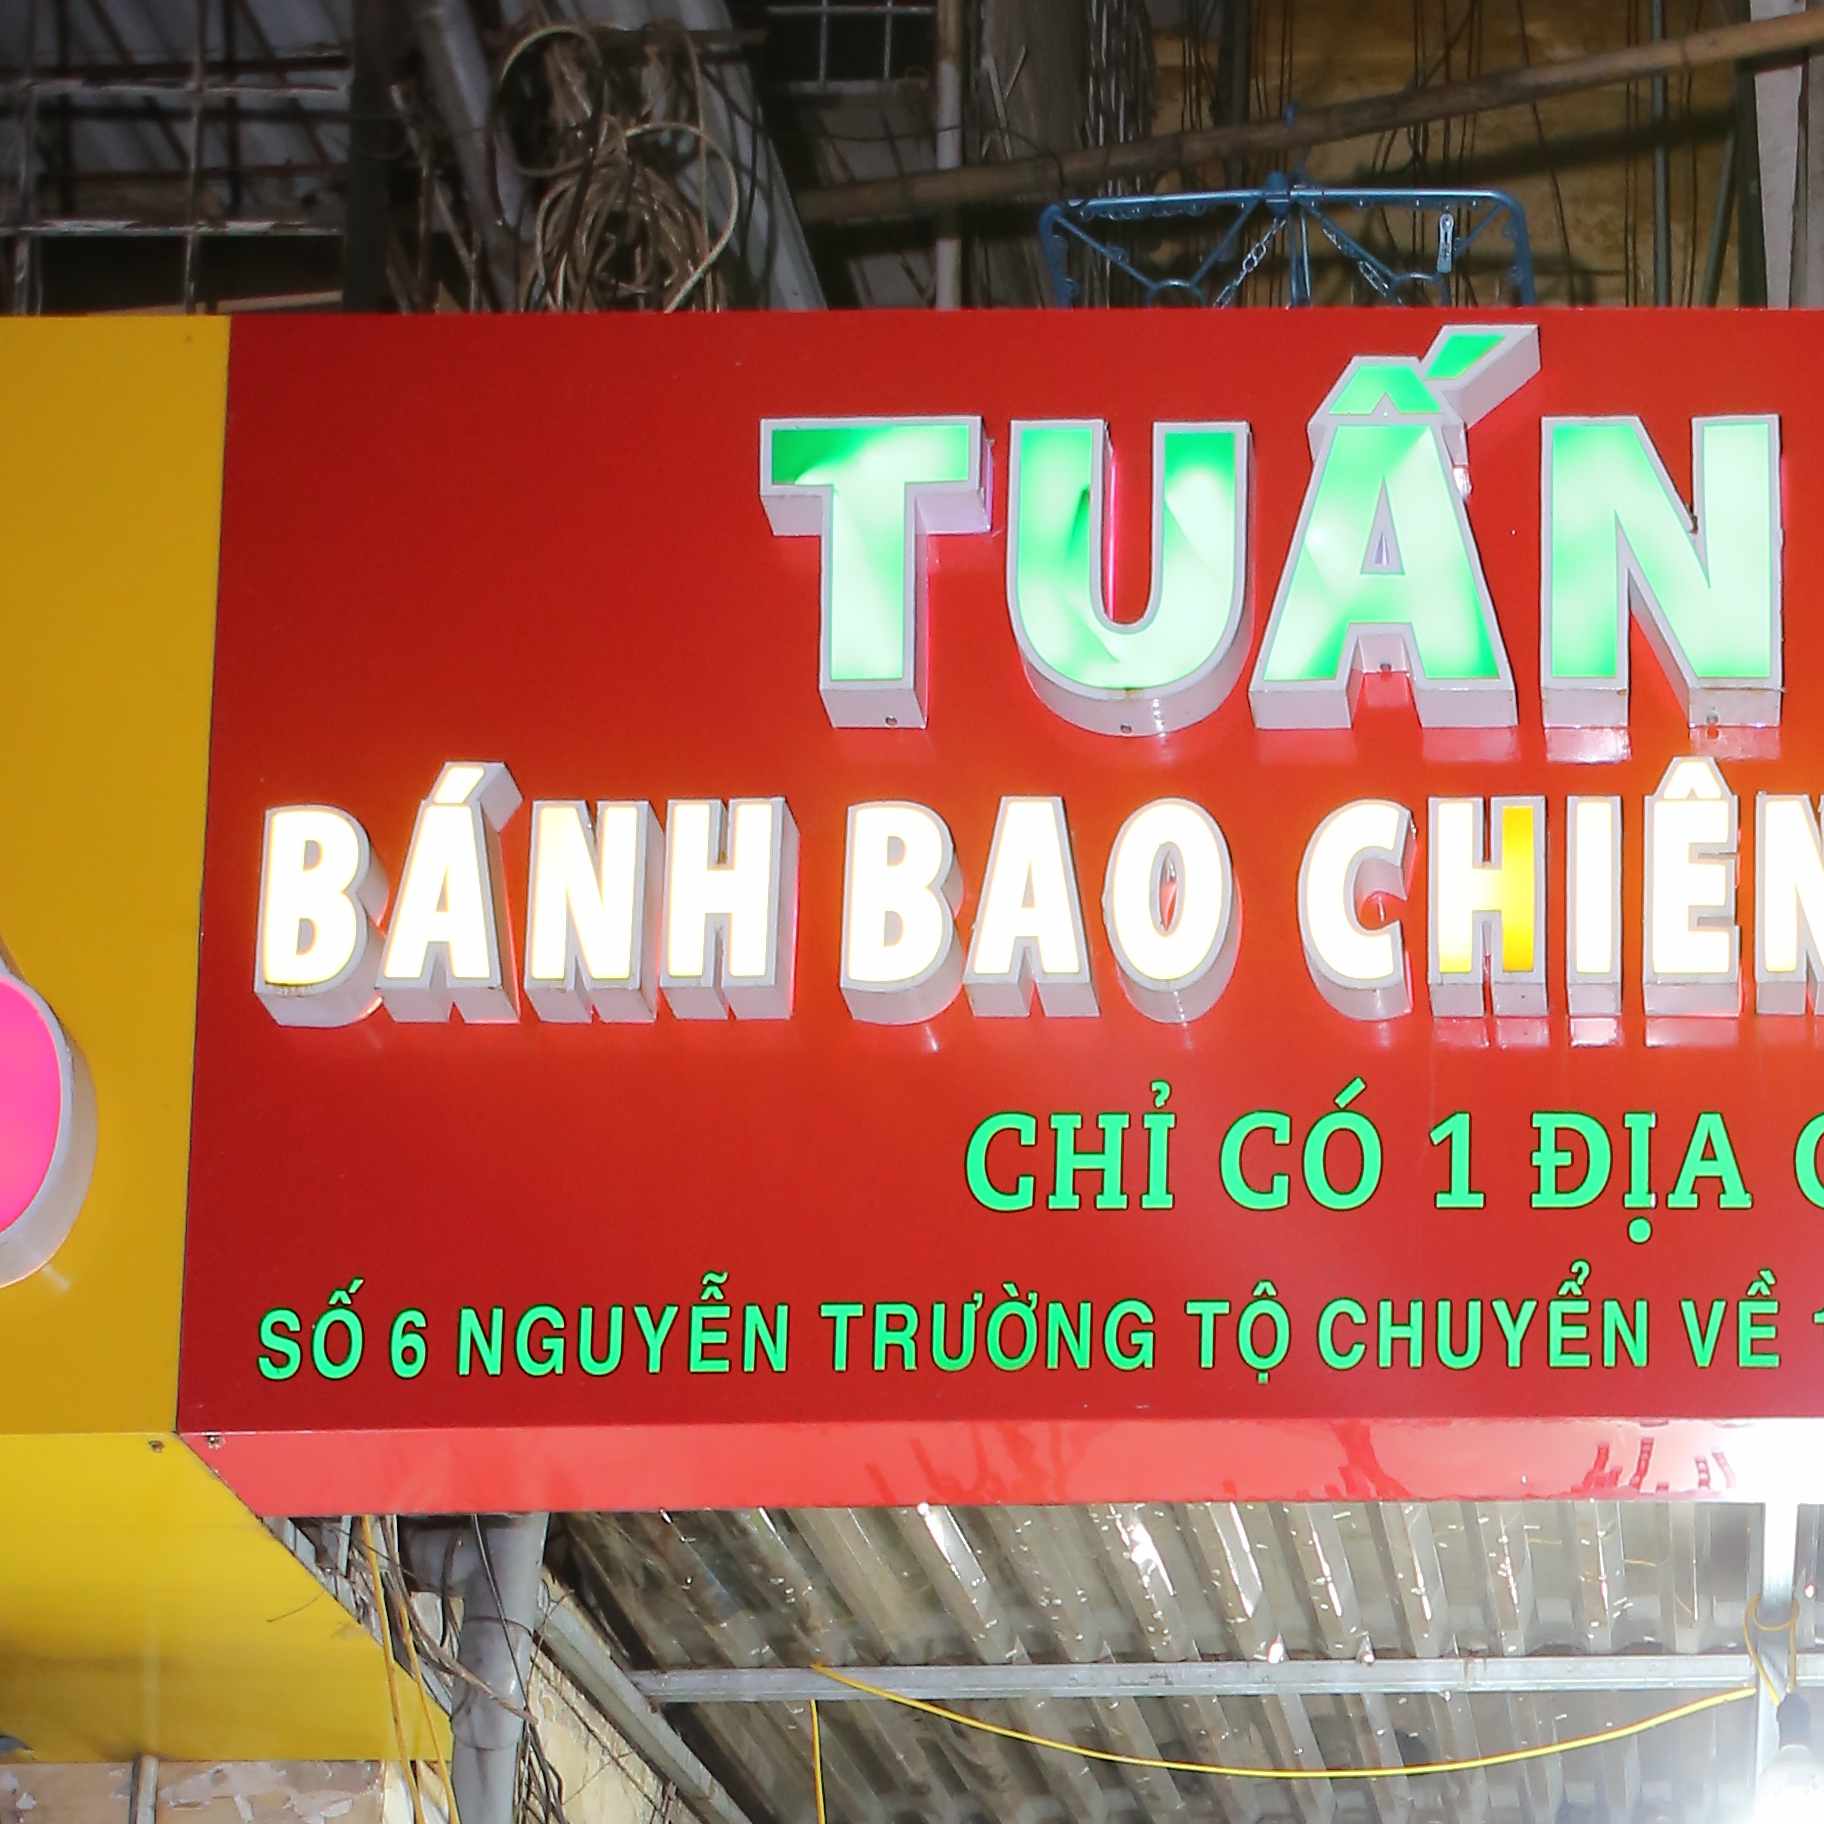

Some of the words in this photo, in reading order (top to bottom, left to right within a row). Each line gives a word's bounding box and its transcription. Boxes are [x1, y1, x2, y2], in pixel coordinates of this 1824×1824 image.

[759, 324, 1784, 737] TUẤN
[254, 761, 798, 1026] BÁNH
[838, 797, 1234, 1028] BAO
[965, 1079, 1176, 1212] CHỈ
[1219, 1076, 1382, 1211] CÓ
[1429, 1111, 1485, 1209] 1
[1530, 1111, 1753, 1244] ĐỊA
[257, 1277, 364, 1381] SỐ
[389, 1308, 427, 1379] 6
[457, 1271, 789, 1377] NGUYỄN
[819, 1281, 1155, 1372] TRƯỜNG
[1185, 1279, 1291, 1384] TỘ
[1317, 1259, 1649, 1370] CHUYỂN
[1681, 1268, 1780, 1368] VỀ
